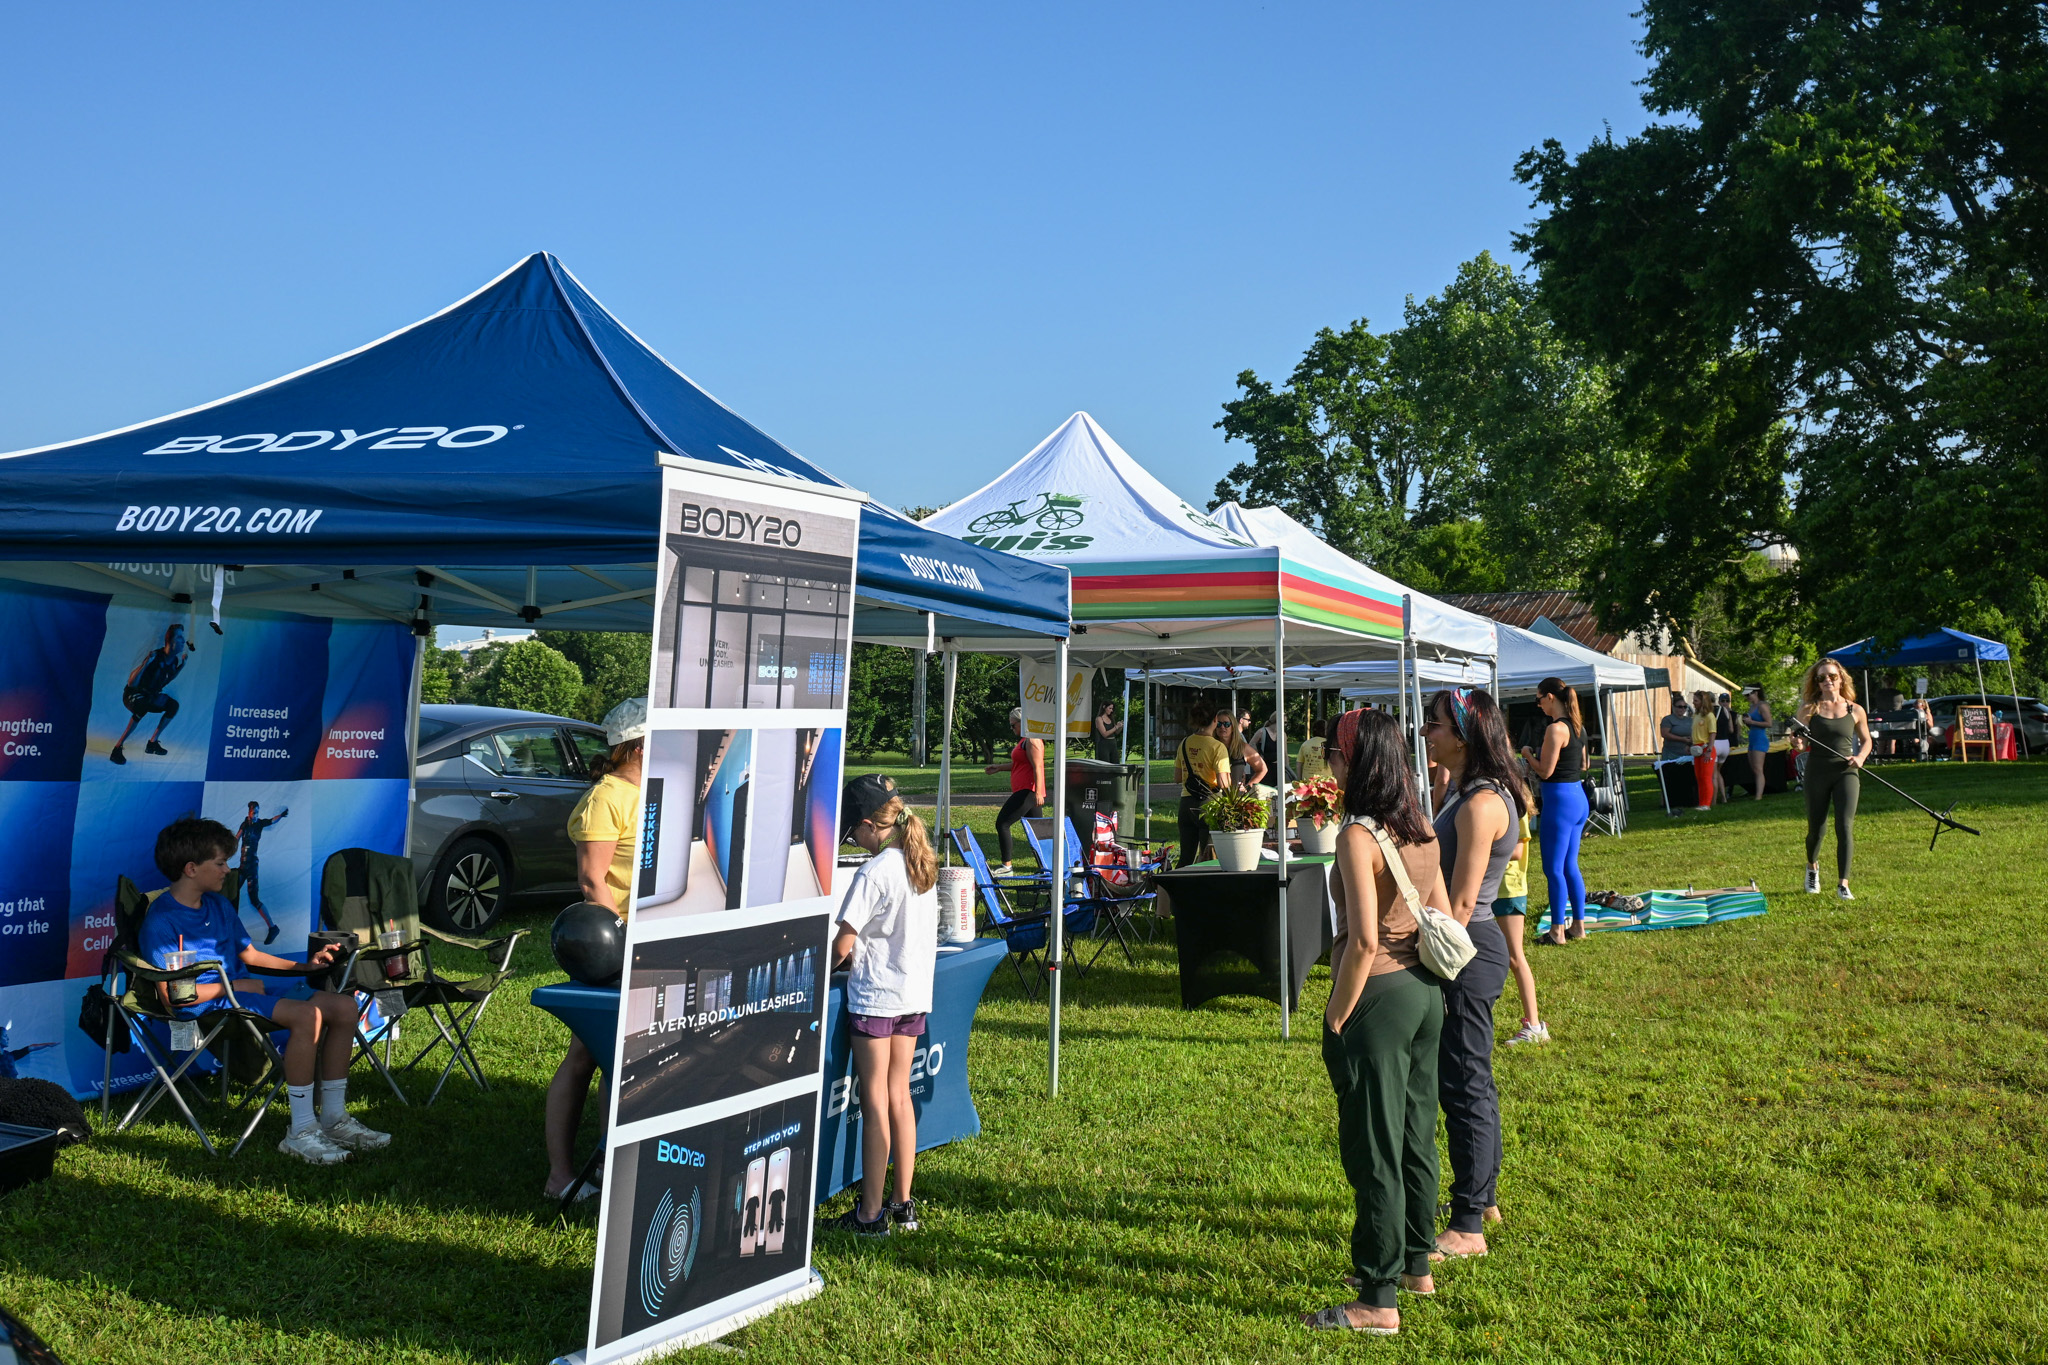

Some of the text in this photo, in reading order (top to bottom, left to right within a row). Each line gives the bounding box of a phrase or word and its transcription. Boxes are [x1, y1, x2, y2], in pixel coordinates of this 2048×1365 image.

[143, 425, 509, 456] BODY20
[115, 506, 323, 533] BODY20.COM
[680, 503, 802, 548] BODY20
[900, 553, 984, 591] BODY20.COM
[229, 705, 288, 720] Increased
[0, 718, 53, 737] ngthen
[226, 725, 291, 742] Strength +
[328, 728, 384, 742] Improved
[3, 741, 41, 756] Core.
[224, 745, 290, 759] Endurance.
[326, 747, 379, 759] Posture.
[18, 897, 45, 912] that
[2, 919, 50, 935] on the
[743, 1122, 801, 1155] STEP INTO YOU
[657, 1139, 706, 1168] BODY20
